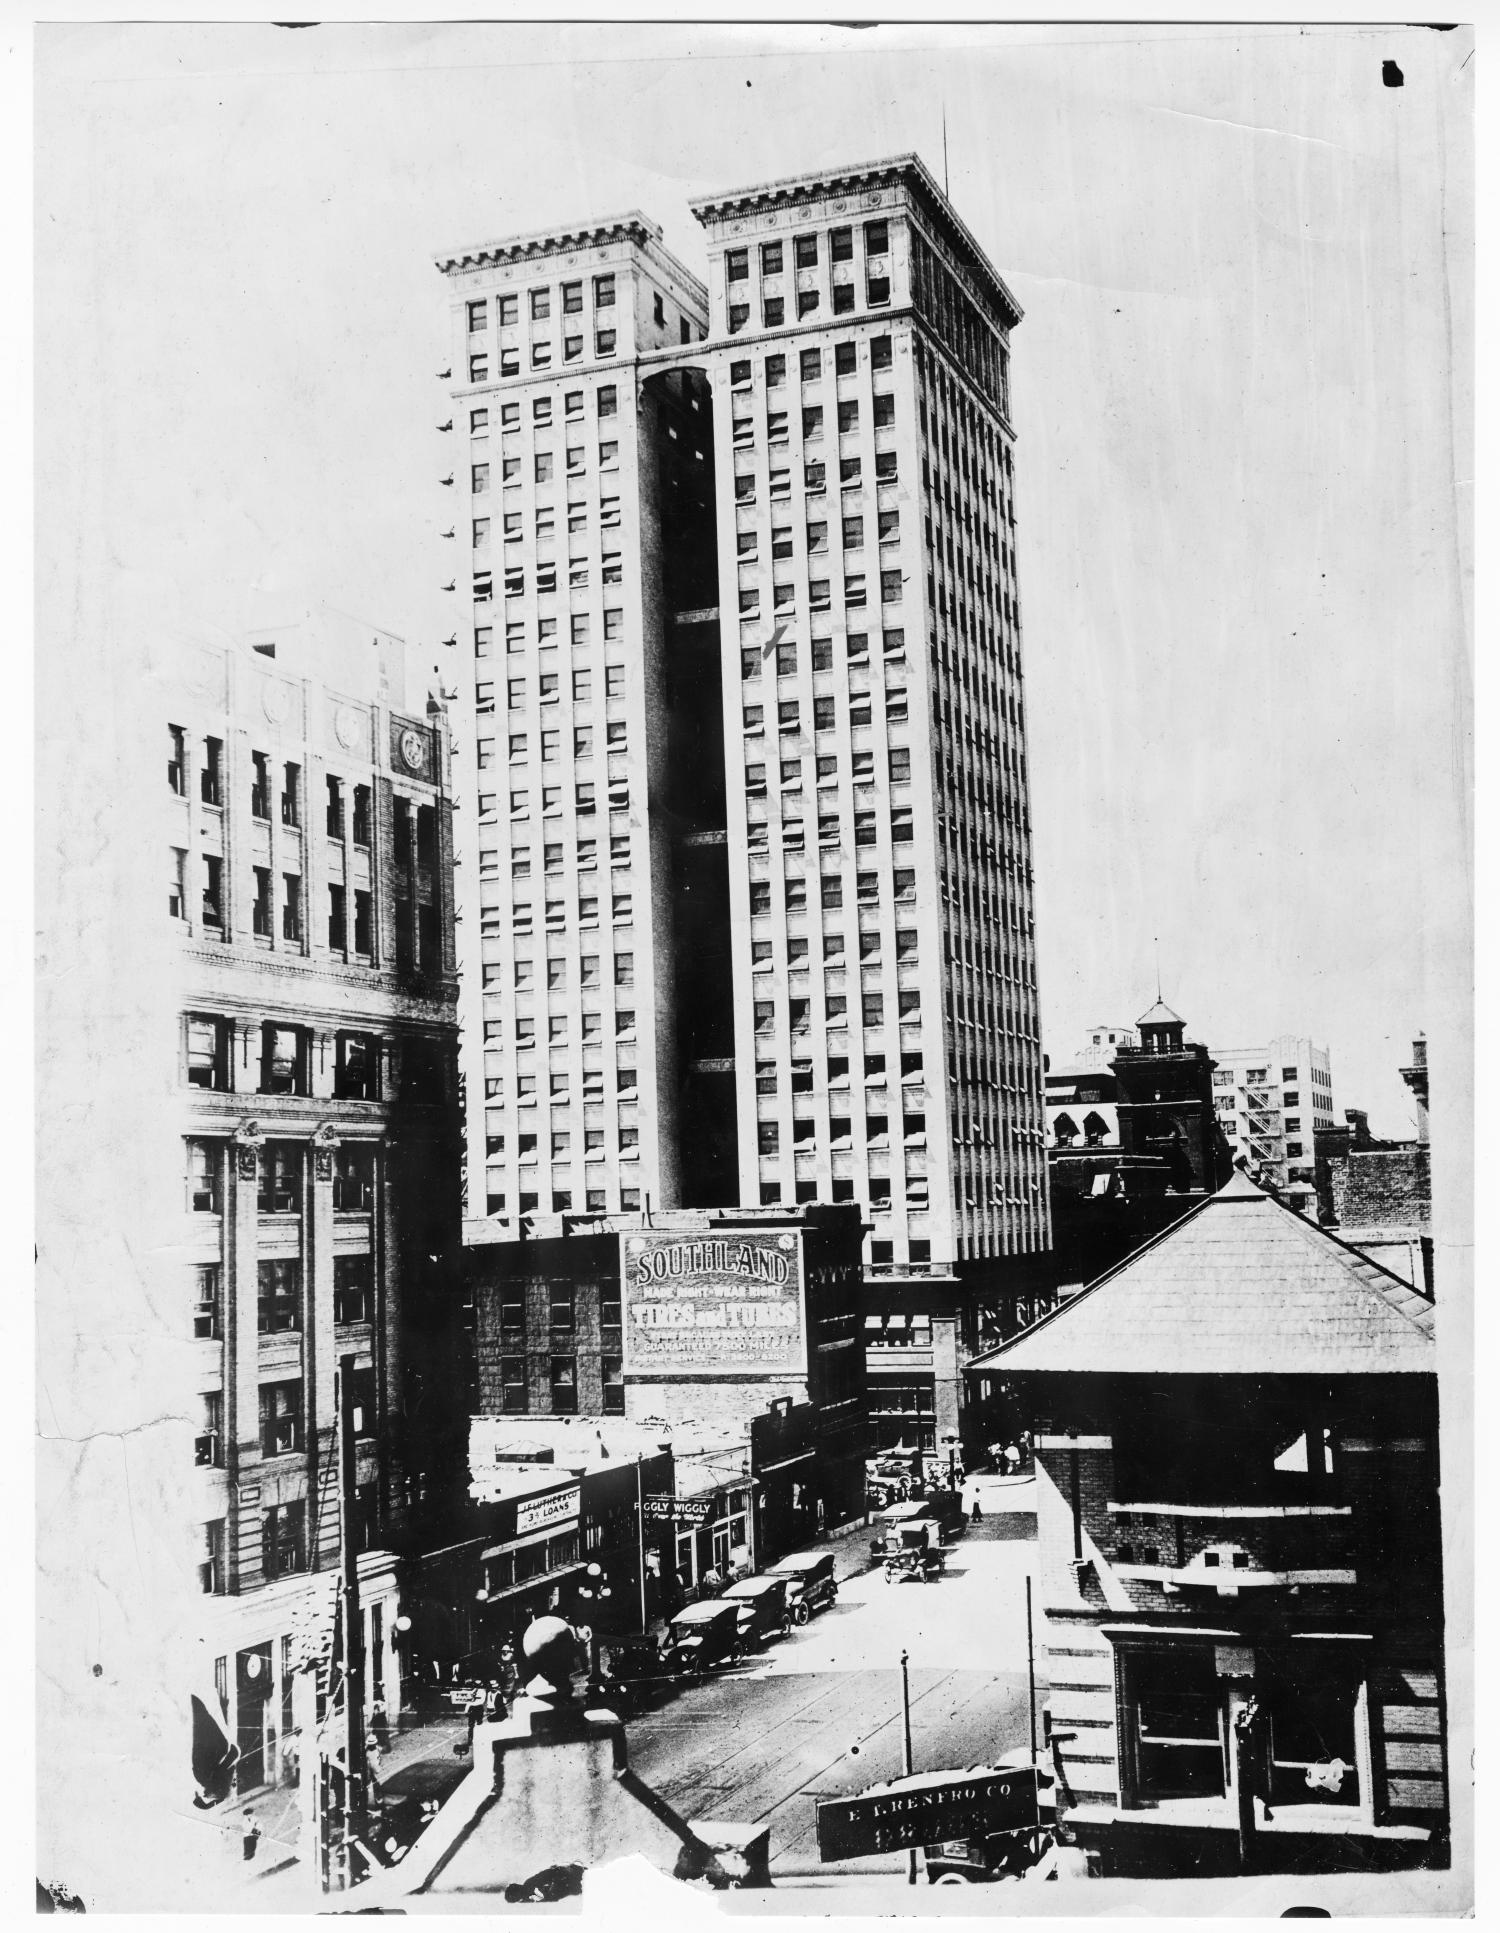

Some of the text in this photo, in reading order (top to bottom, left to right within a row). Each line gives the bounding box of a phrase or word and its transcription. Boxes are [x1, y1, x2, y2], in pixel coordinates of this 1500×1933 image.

[637, 1241, 789, 1286] SOUTHLAND
[631, 1303, 695, 1328] TIRES
[727, 1302, 797, 1327] TUBES
[543, 1502, 570, 1517] LOANS
[634, 1502, 711, 1514] PGGLY WIGGLY
